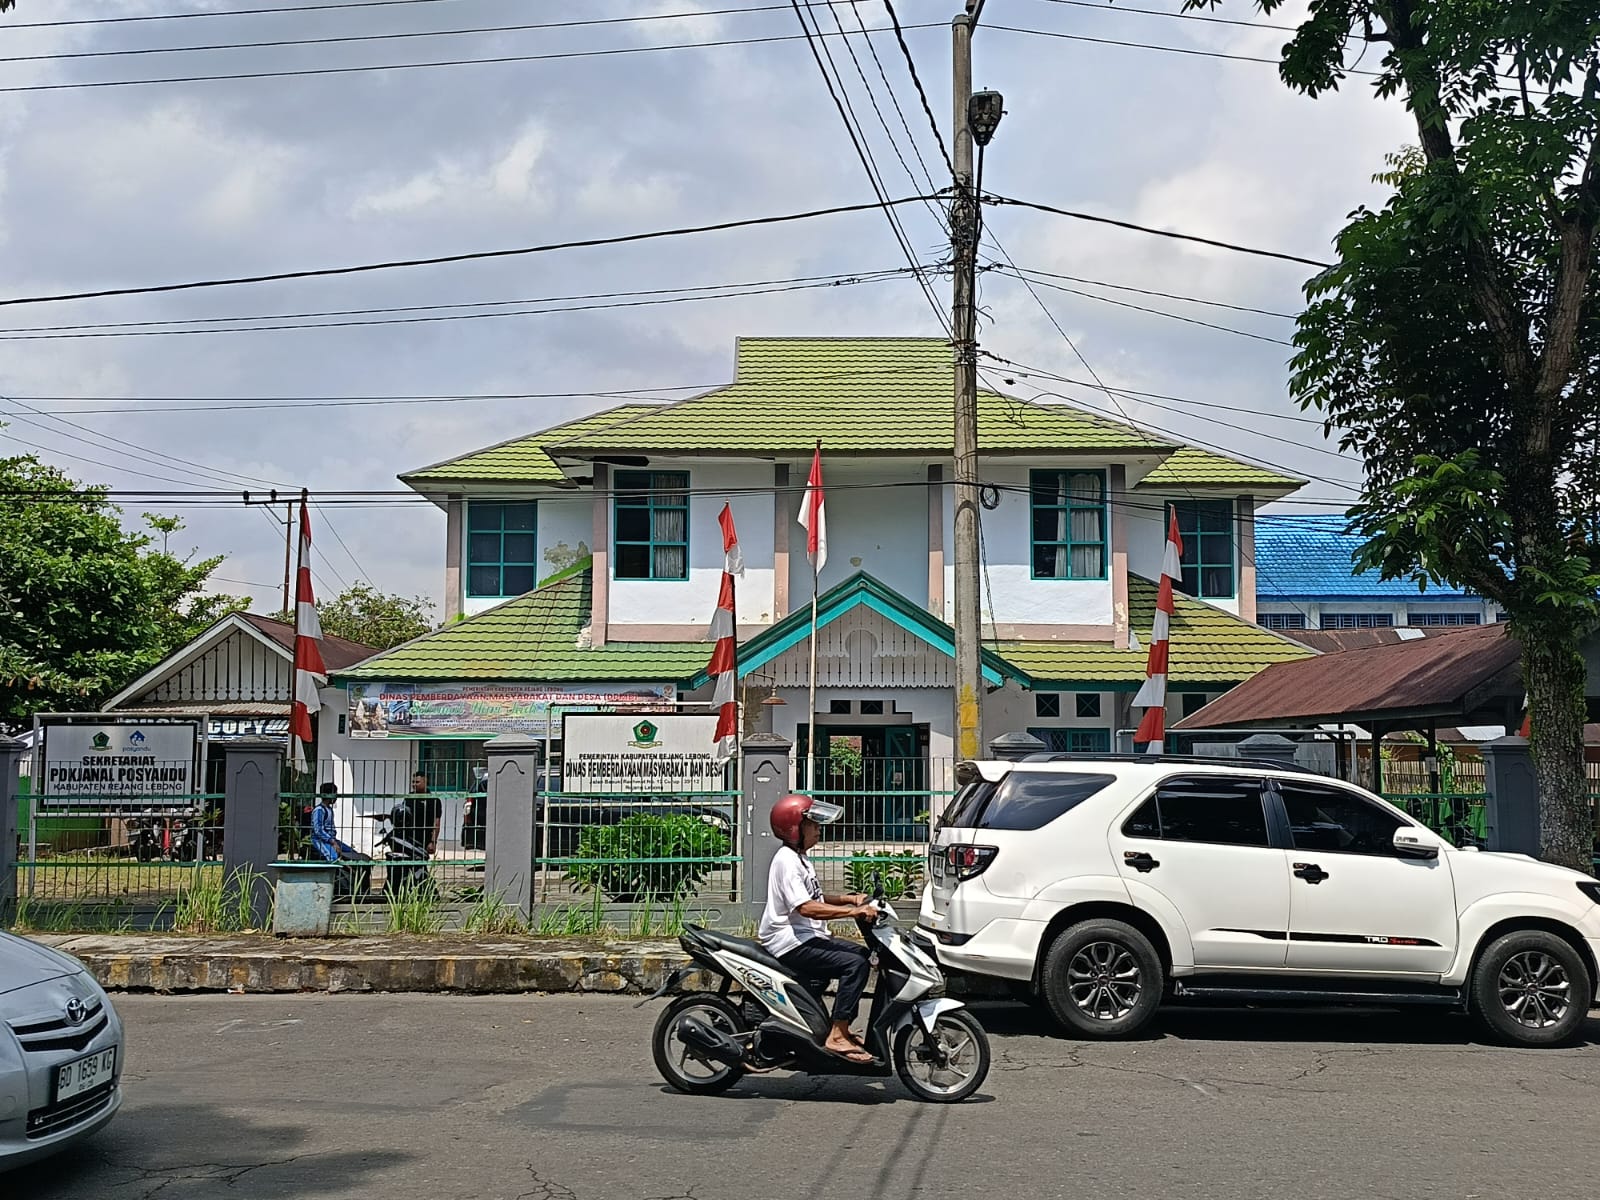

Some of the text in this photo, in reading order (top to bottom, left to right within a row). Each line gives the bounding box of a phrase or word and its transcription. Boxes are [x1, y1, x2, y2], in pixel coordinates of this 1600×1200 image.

[379, 693, 408, 701] DINAS
[555, 693, 576, 701] DAN
[577, 693, 601, 701] DESA
[208, 719, 266, 734] COPY
[82, 755, 156, 766] SEKRETARIAT
[117, 767, 187, 782] POSYANDU
[565, 761, 722, 777] DINAS PEMBERDAYAAN MASYARAKAT DAN DESA
[53, 783, 183, 791] KABUPATEN REJANG LEBONG
[1364, 935, 1389, 943] TRD
[60, 1066, 73, 1089] BD
[78, 1055, 98, 1082] 1659
[102, 1050, 113, 1072] KG
